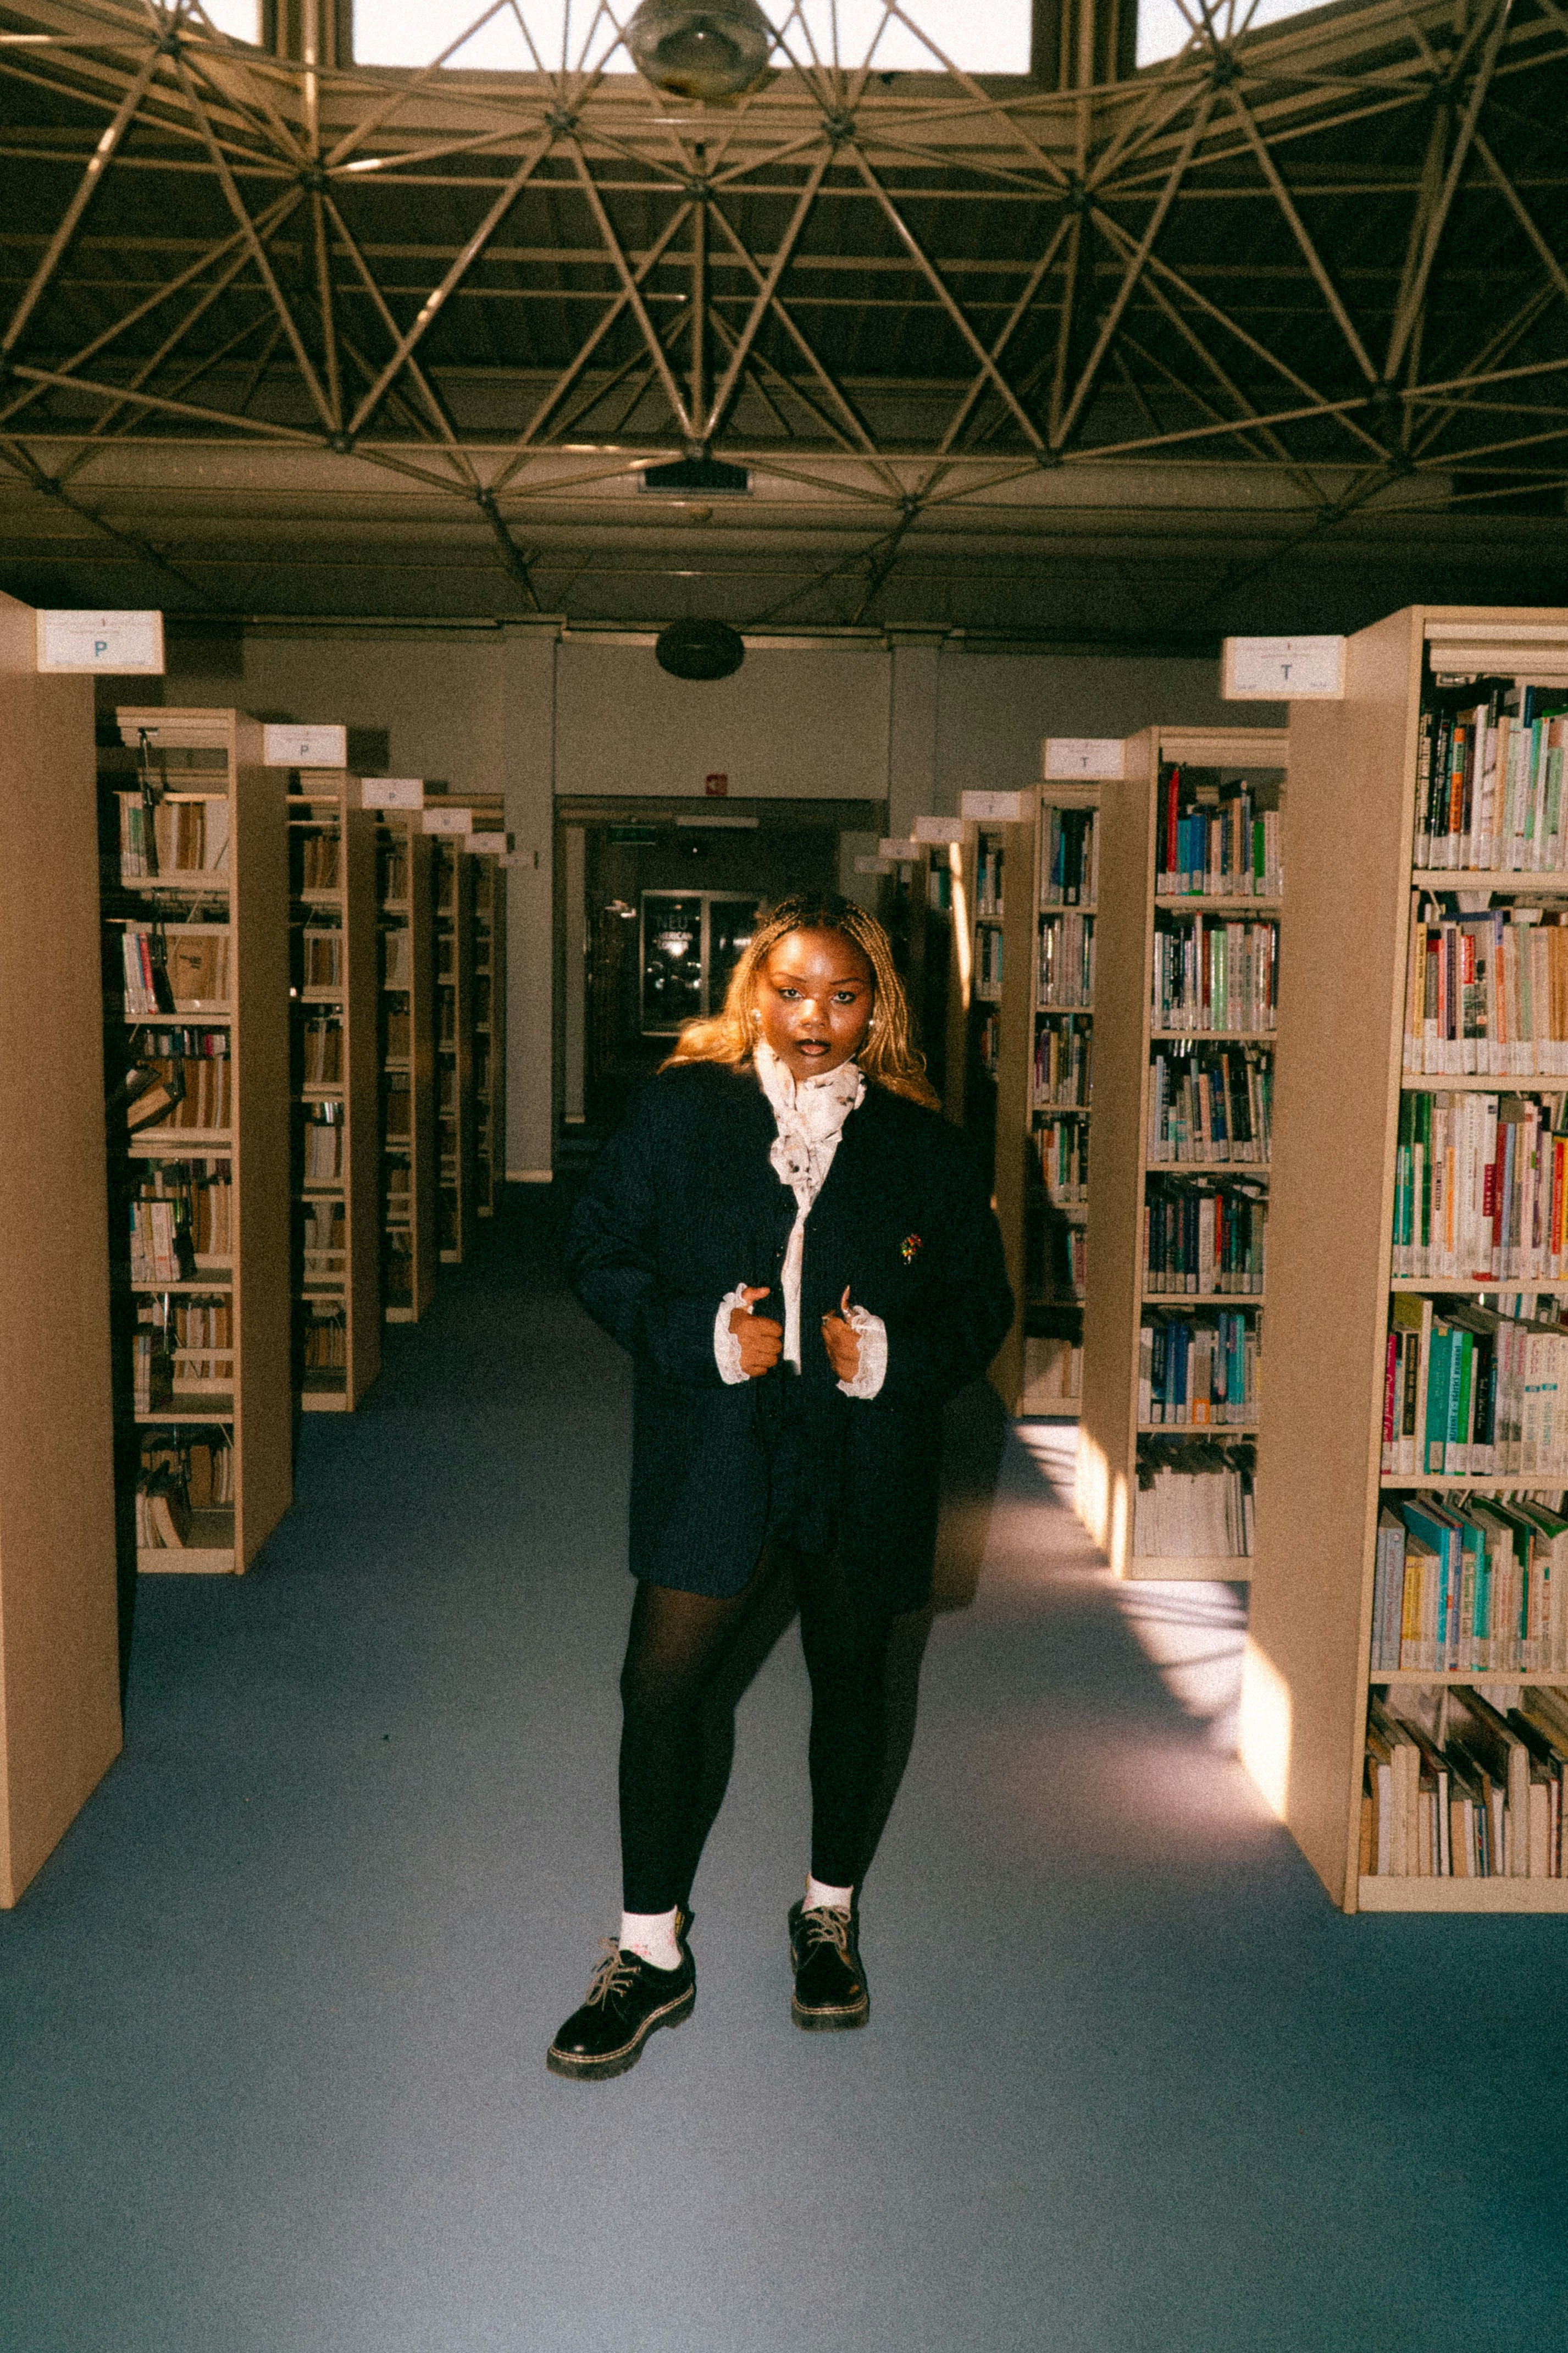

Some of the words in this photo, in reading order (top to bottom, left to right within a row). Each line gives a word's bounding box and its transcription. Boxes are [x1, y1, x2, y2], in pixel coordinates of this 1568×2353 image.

[95, 640, 108, 657] P
[1281, 664, 1292, 680] T
[301, 745, 309, 756] P
[1079, 757, 1089, 767] T
